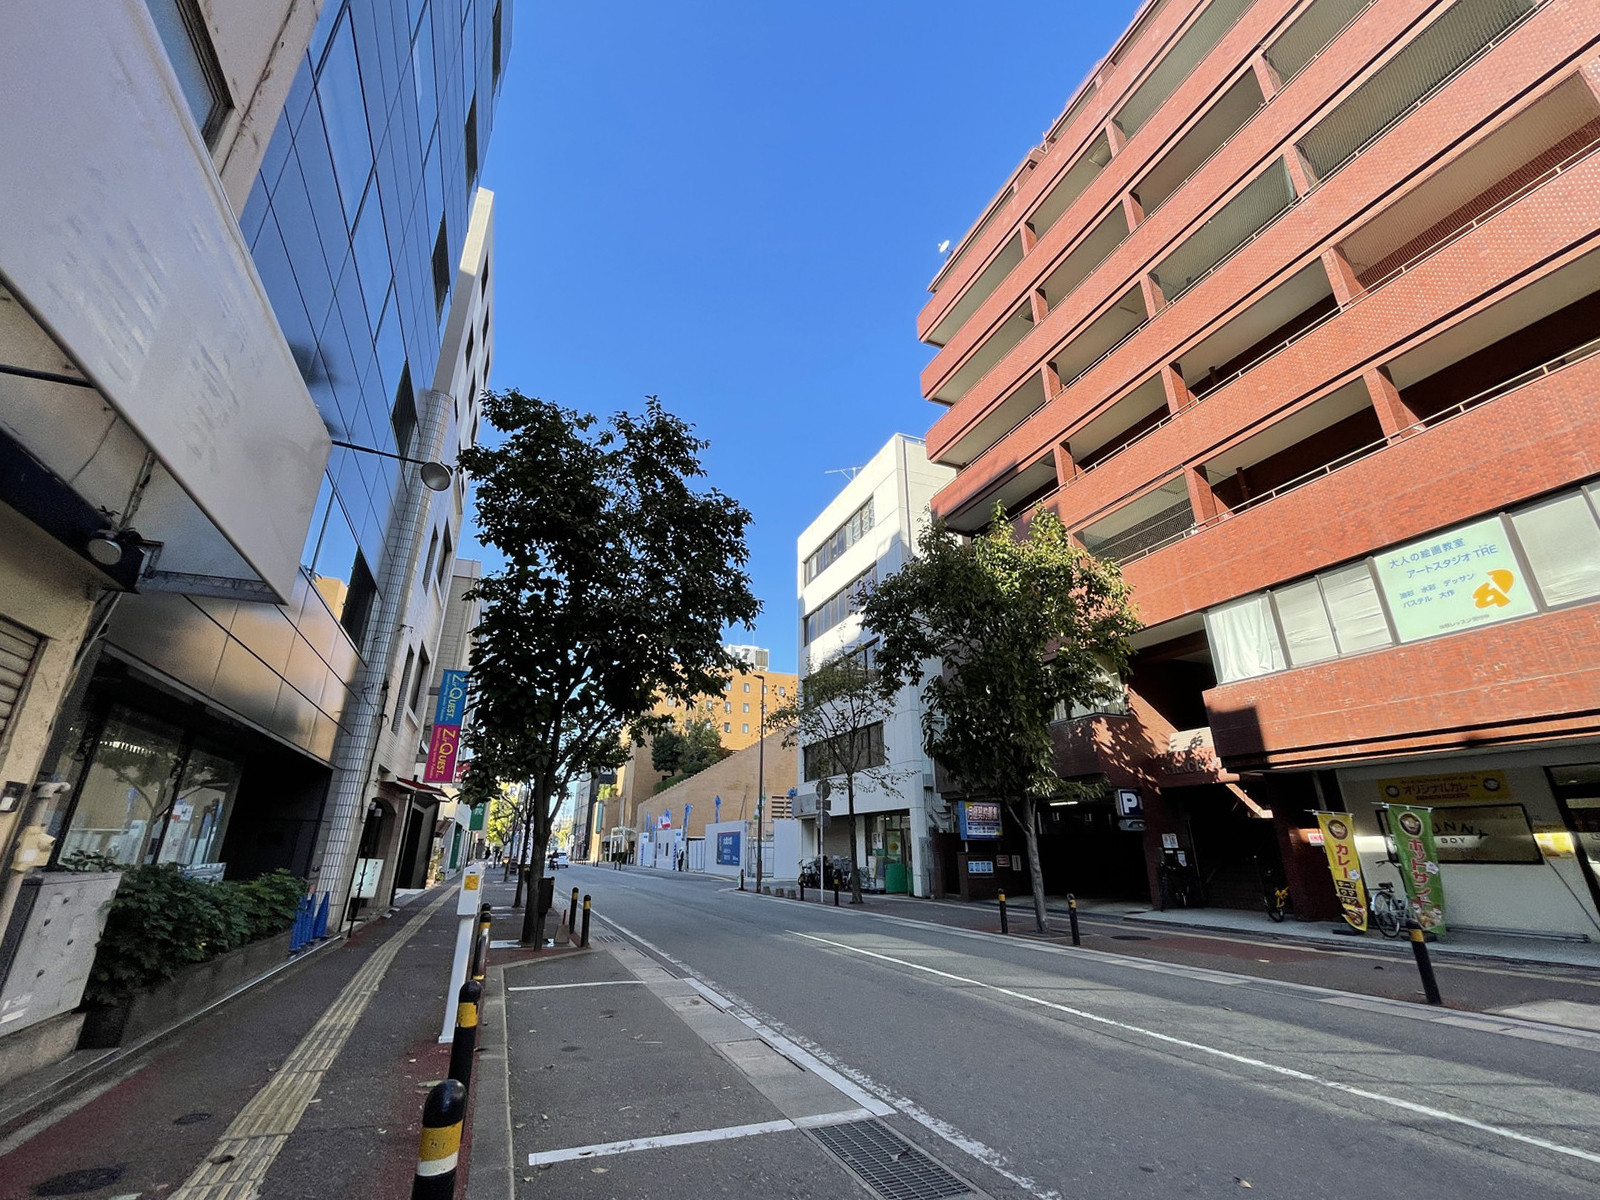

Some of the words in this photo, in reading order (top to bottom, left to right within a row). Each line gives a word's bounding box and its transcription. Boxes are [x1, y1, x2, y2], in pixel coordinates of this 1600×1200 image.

[1389, 537, 1466, 569] 大人の絵画教室
[1406, 552, 1471, 579] アートスタジオ
[1473, 544, 1498, 560] TRE
[1443, 573, 1475, 587] デッサン
[1403, 597, 1433, 608] パステル
[1402, 782, 1479, 796] オリジナルカレー
[1122, 793, 1138, 813] P
[1335, 844, 1350, 879] カレー
[1408, 839, 1432, 906] ホットサンド
